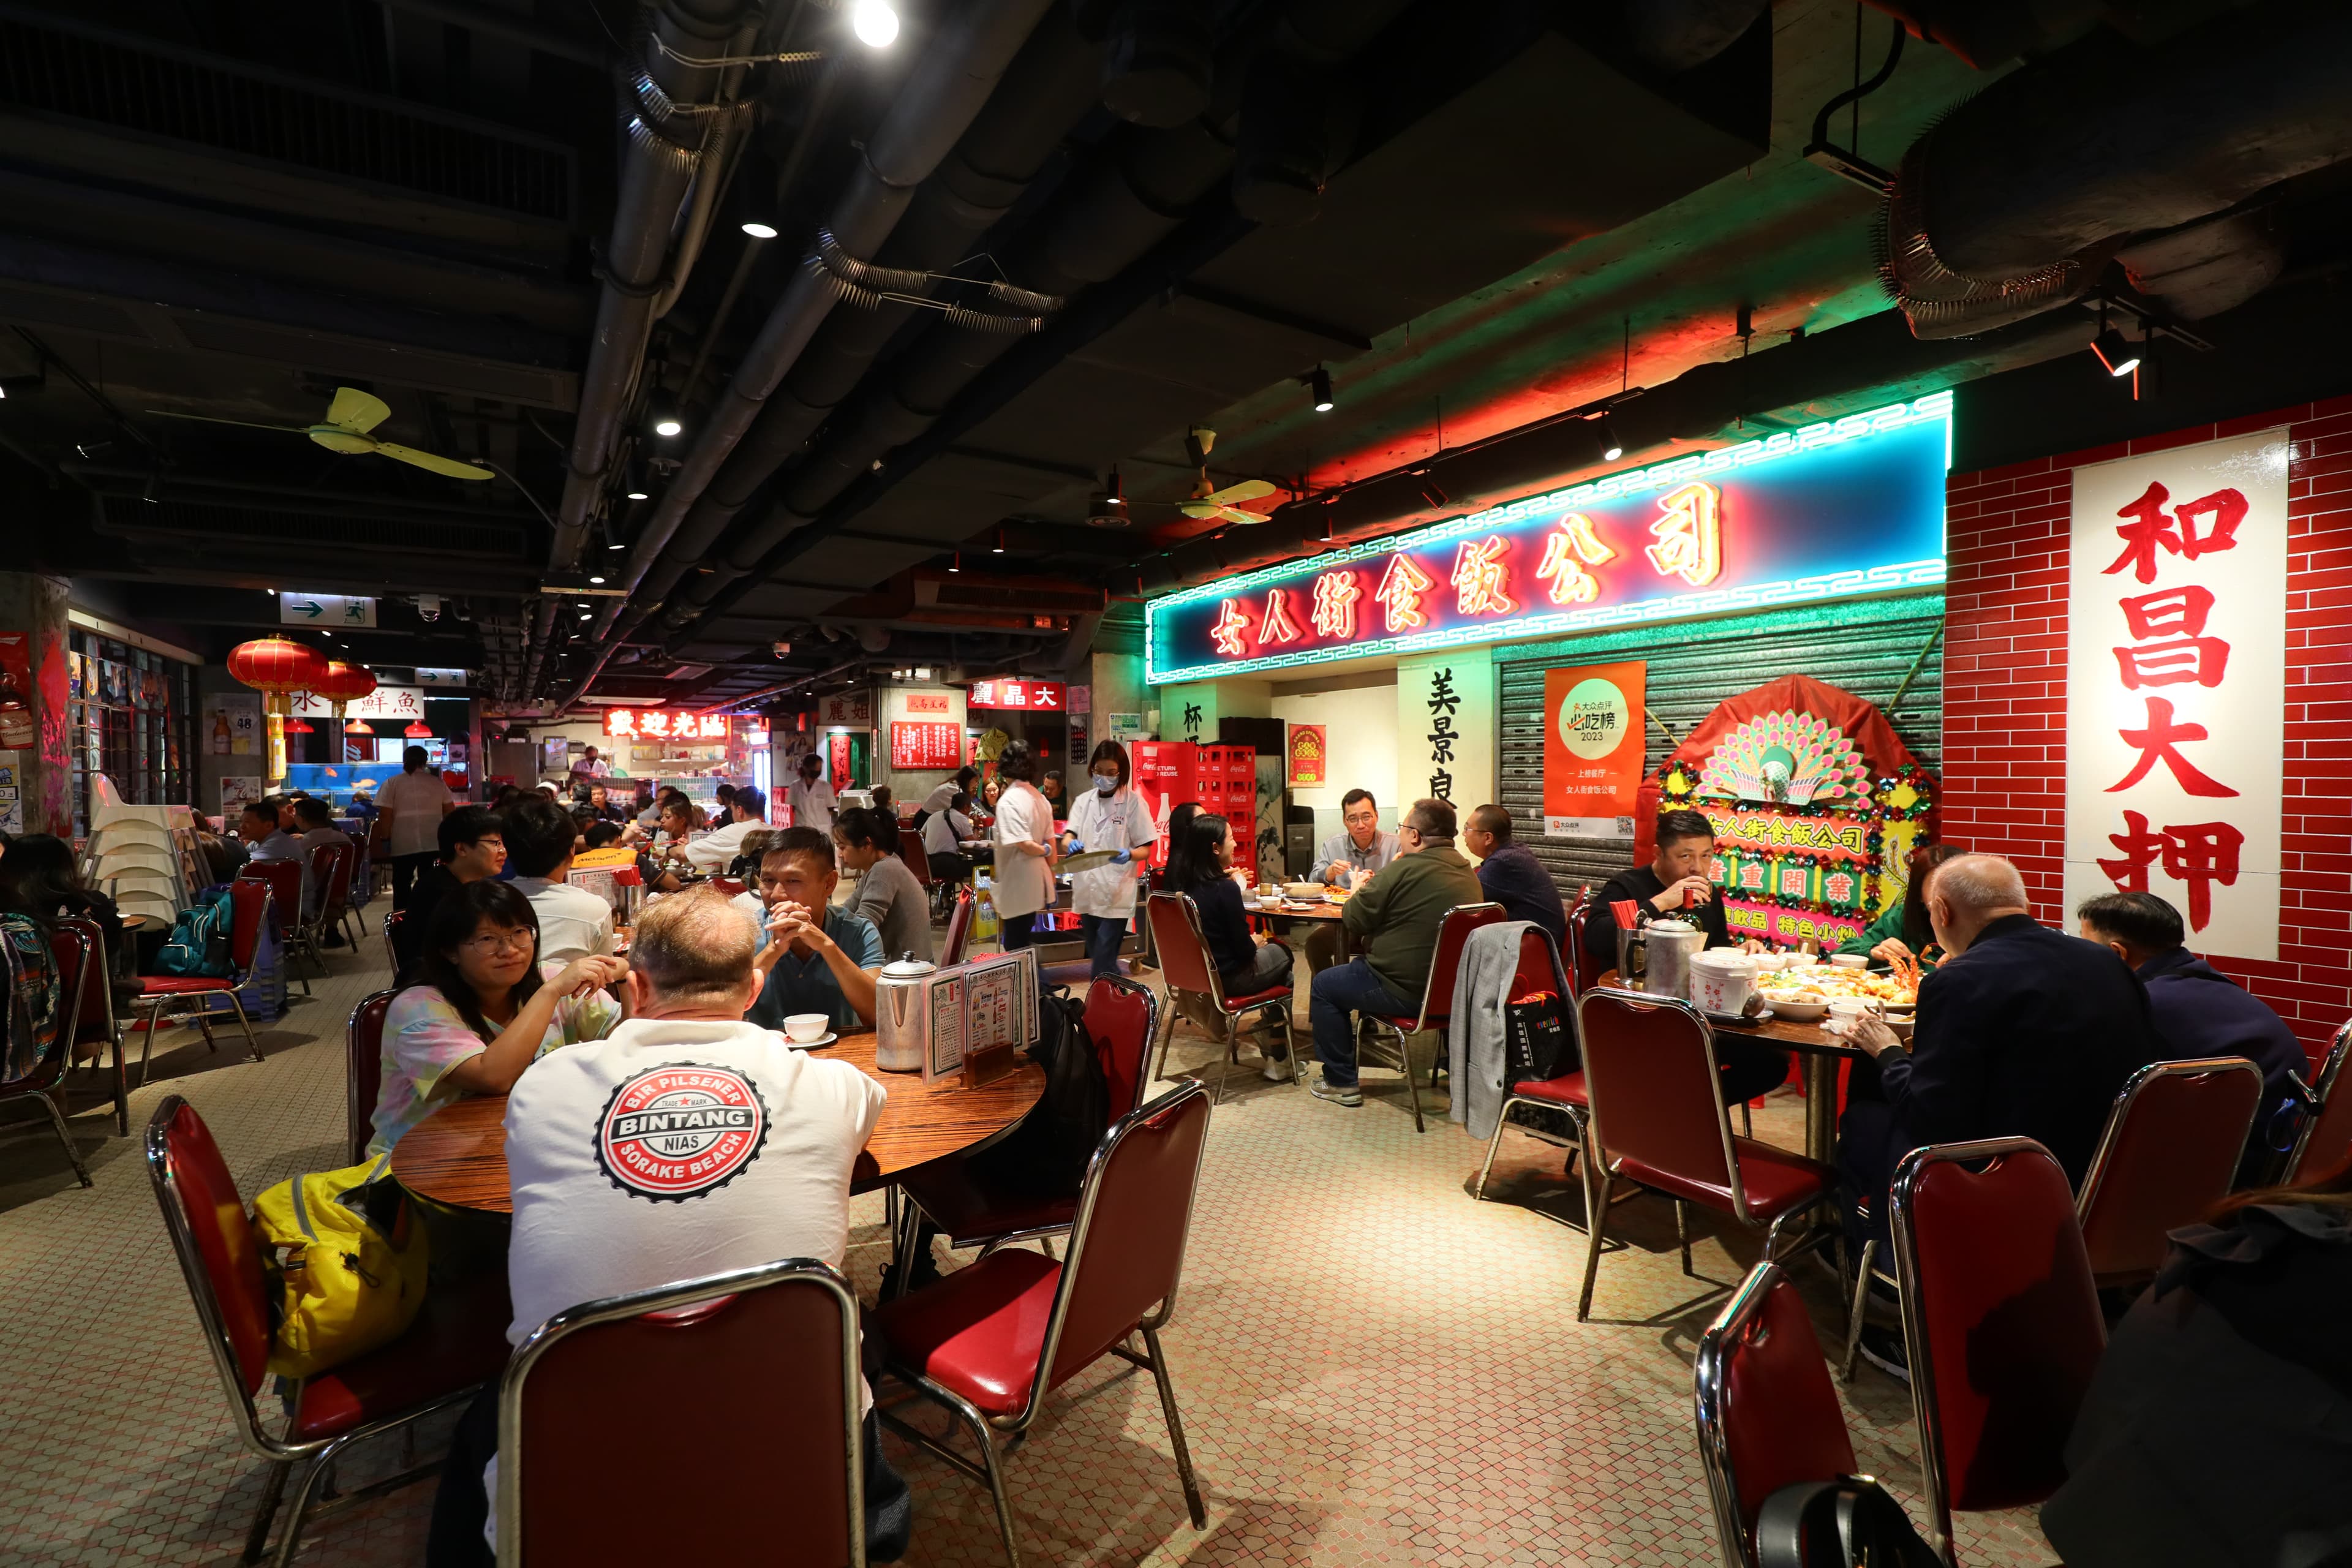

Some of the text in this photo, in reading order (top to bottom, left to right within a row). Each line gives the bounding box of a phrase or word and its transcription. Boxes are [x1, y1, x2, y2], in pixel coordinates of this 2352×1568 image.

[1210, 481, 1722, 655] 女人街食飯公司
[292, 690, 419, 714] 水鮮魚
[1582, 701, 1613, 712] 大众点评
[2097, 481, 2250, 935] 和昌大押
[237, 718, 252, 729] 48
[608, 709, 726, 737] 歡迎光臨
[1566, 712, 1616, 731] 必吃榜
[1427, 667, 1461, 810] 美景良
[1581, 731, 1604, 741] 2023
[1577, 769, 1607, 778] 上榜餐厅
[1707, 813, 1864, 854] 女人街食飯公司
[625, 1076, 743, 1109] BIR PILSENER
[690, 1098, 707, 1107] MARK
[619, 1110, 746, 1136] BINTANG
[620, 1133, 743, 1179] SORAKE BEACH
[664, 1135, 699, 1152] NIAS
